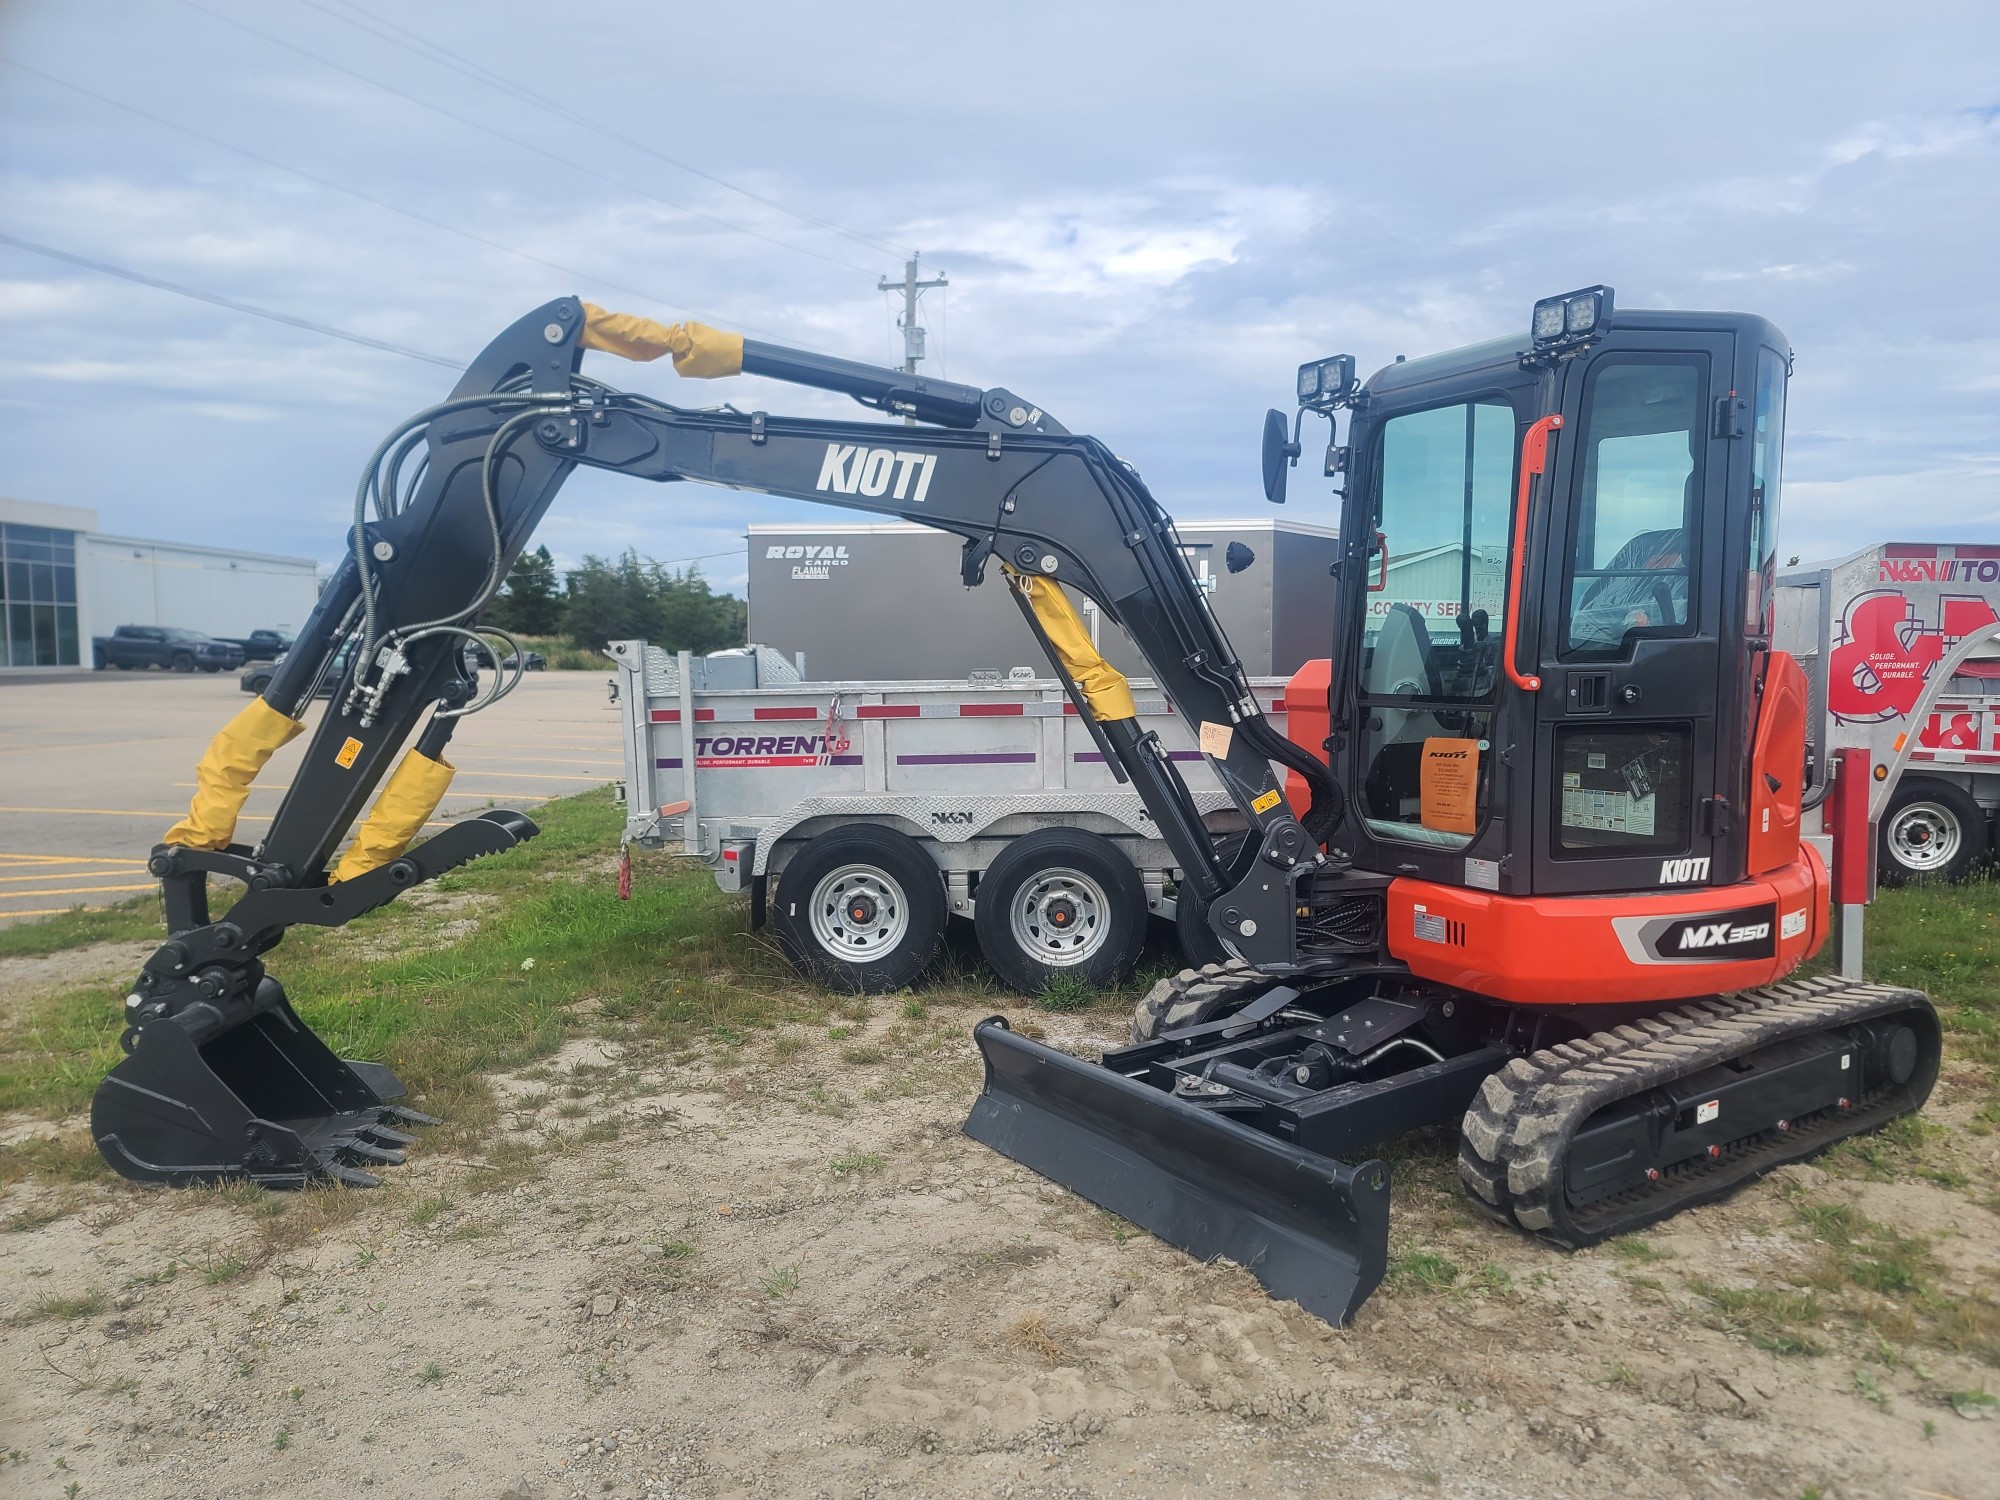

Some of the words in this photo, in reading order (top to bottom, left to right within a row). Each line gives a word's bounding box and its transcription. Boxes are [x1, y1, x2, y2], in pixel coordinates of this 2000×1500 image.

[816, 443, 938, 502] KIOTI
[766, 545, 850, 559] ROYAL
[791, 566, 830, 575] FLAMAN
[1879, 560, 1937, 582] N&N
[1961, 560, 2000, 583] TO
[1869, 652, 1897, 661] SOLIDE.
[1874, 661, 1921, 670] PERFORMANT.
[1881, 671, 1915, 679] DURABLE.
[695, 735, 837, 756] TORRENT
[1429, 750, 1468, 759] KIOTI
[931, 811, 973, 825] N&N
[1659, 856, 1711, 884] KIOTI
[1678, 922, 1771, 950] MX350
